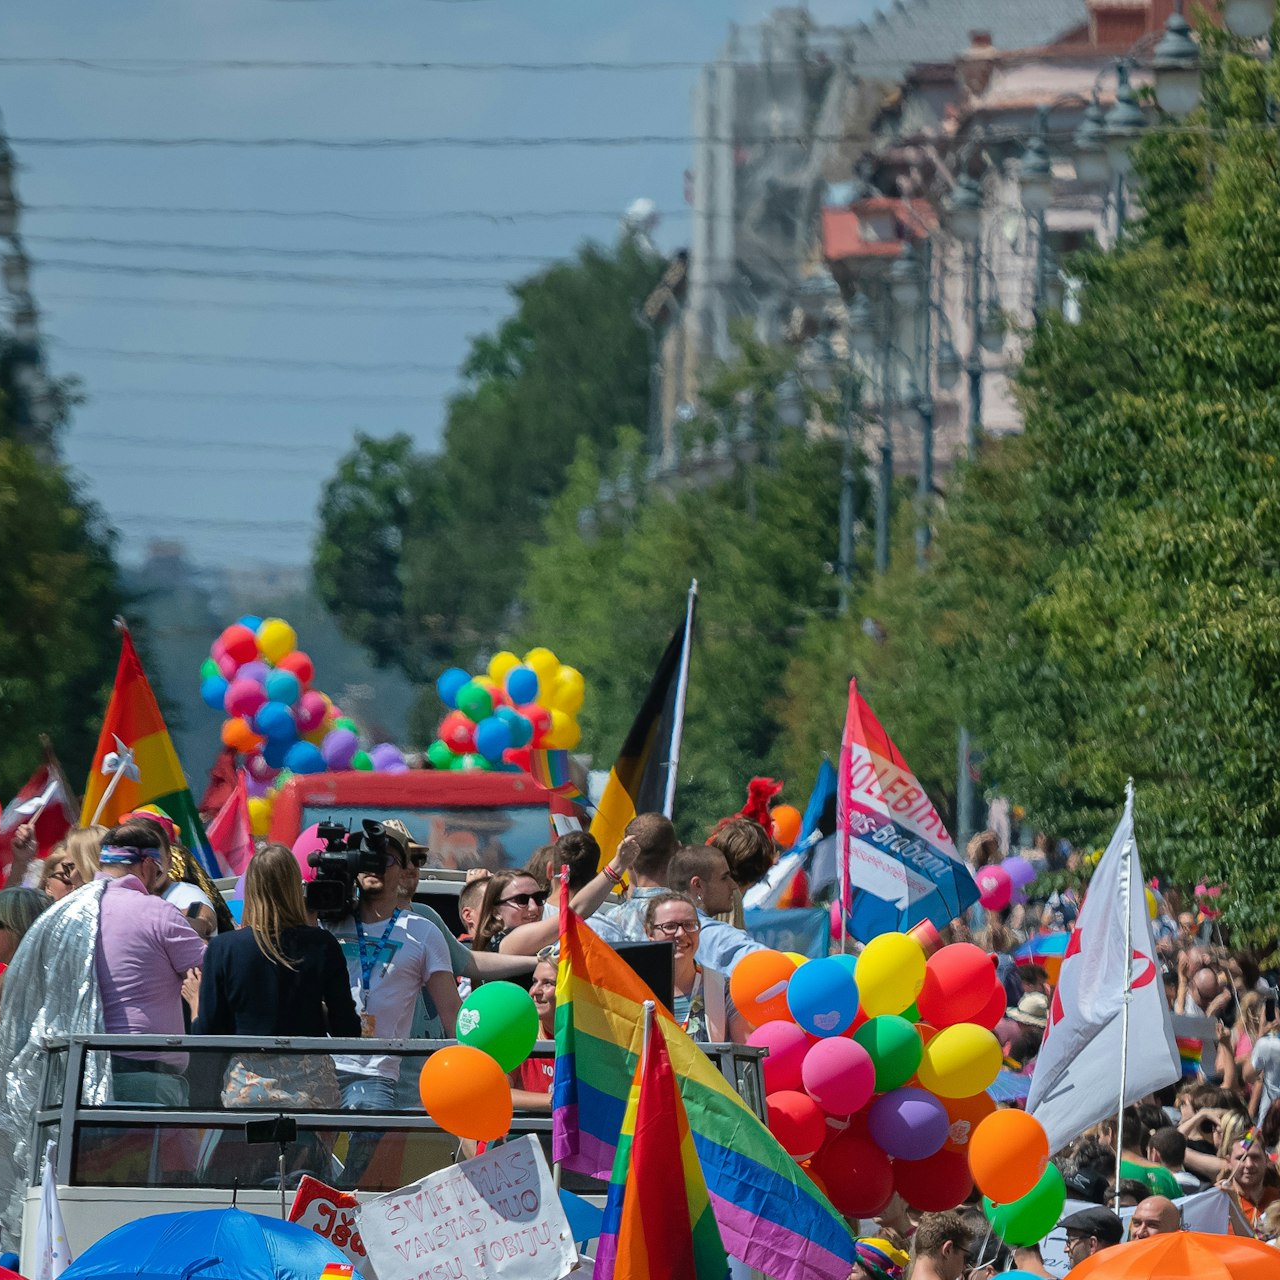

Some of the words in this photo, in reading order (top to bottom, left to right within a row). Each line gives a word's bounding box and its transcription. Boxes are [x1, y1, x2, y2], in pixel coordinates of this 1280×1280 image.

[394, 1209, 487, 1262] VAISTAS
[490, 1188, 539, 1225] NUO
[473, 1221, 557, 1268] FOBIJŲ
